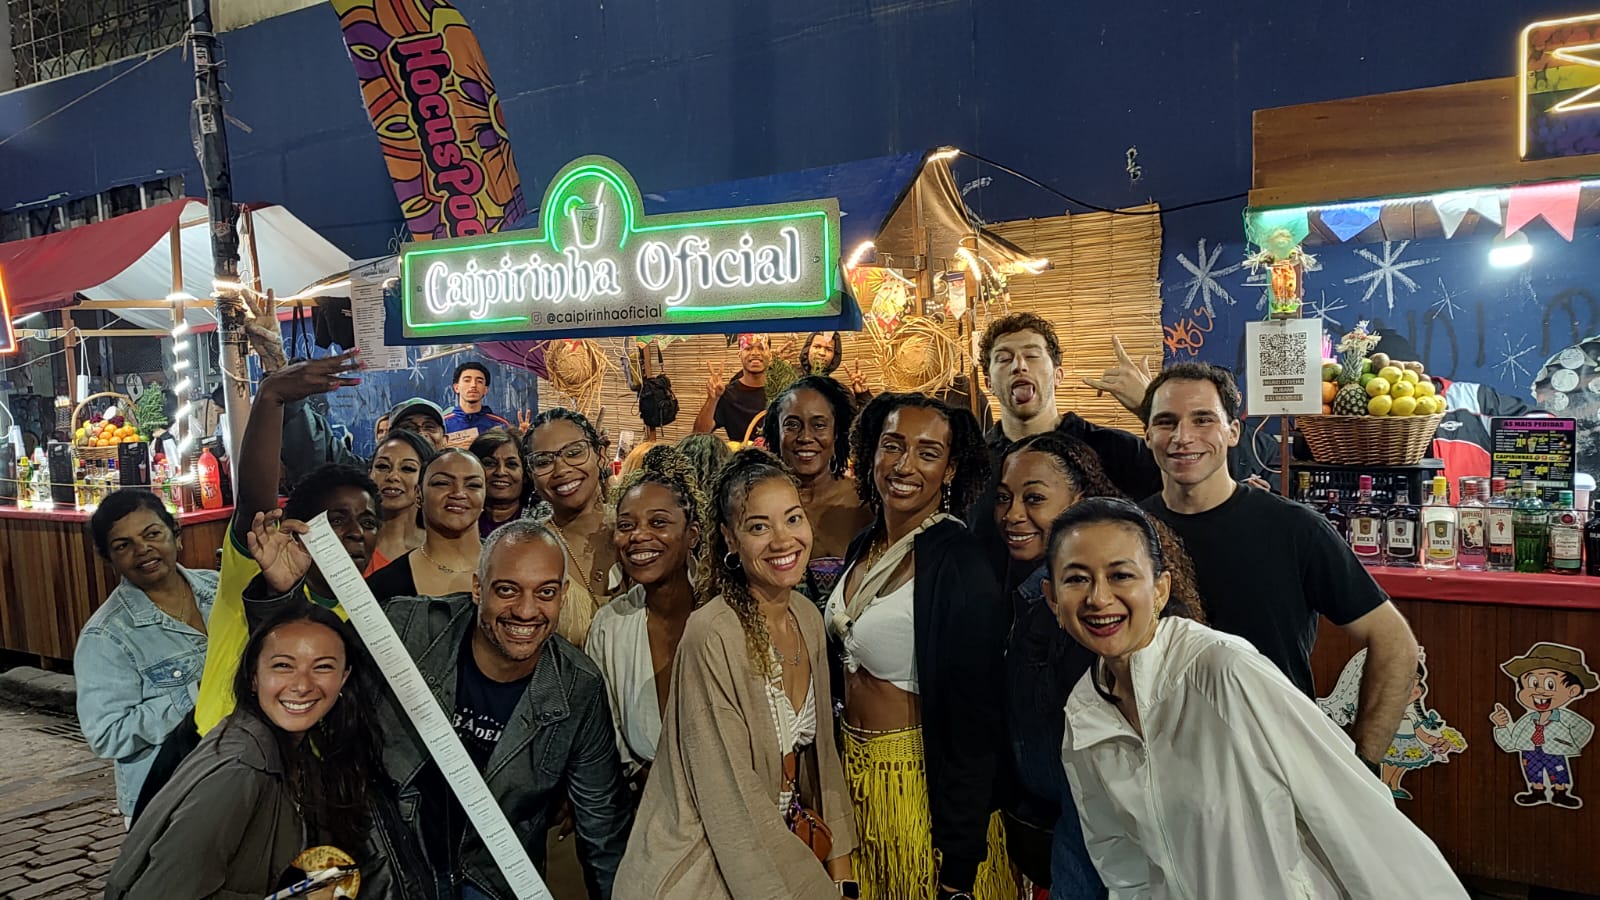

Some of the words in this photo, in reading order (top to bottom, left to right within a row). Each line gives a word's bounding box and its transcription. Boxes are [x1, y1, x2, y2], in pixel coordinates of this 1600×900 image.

[425, 246, 621, 319] Caipirinha
[637, 226, 800, 305] Oficial
[546, 304, 663, 326] @caipirinhaoficial
